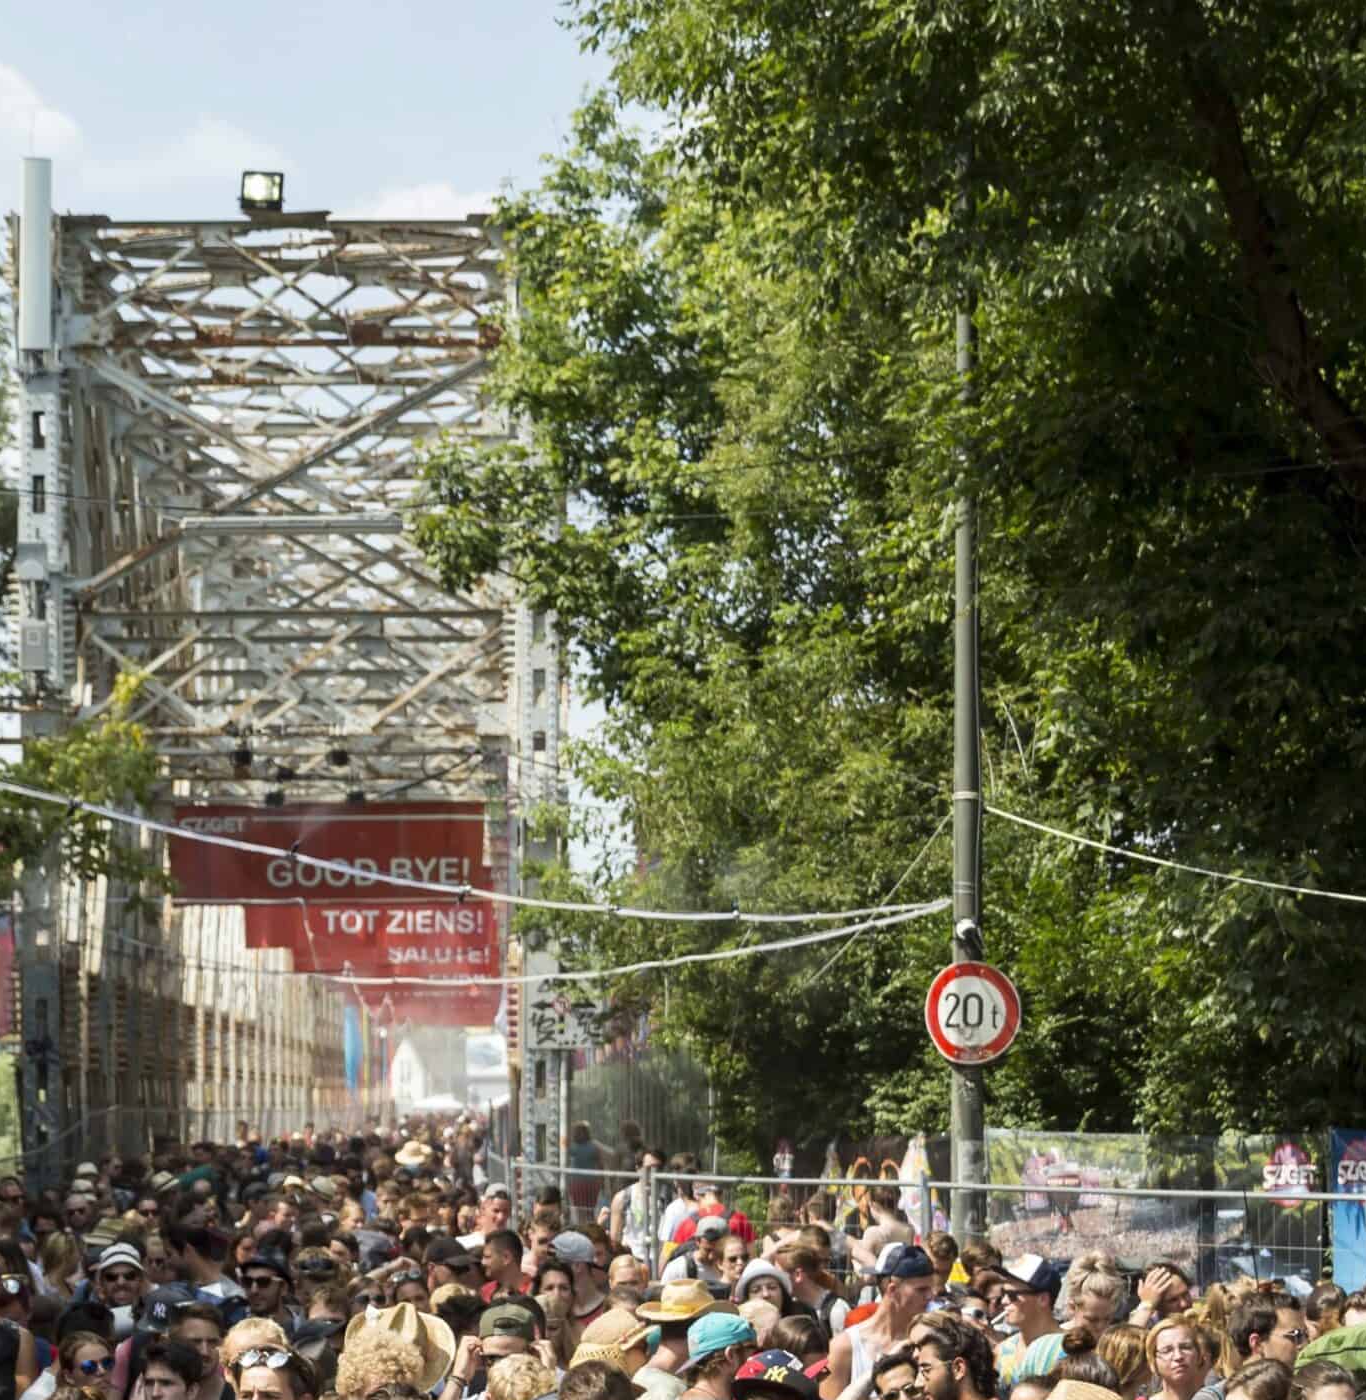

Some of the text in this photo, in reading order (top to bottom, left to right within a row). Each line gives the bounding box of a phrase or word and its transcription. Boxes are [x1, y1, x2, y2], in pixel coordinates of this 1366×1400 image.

[267, 857, 378, 887] GOOD
[390, 856, 471, 886] BYE!
[322, 909, 484, 934] TOT ZIENS!
[945, 993, 1001, 1030] 20 t
